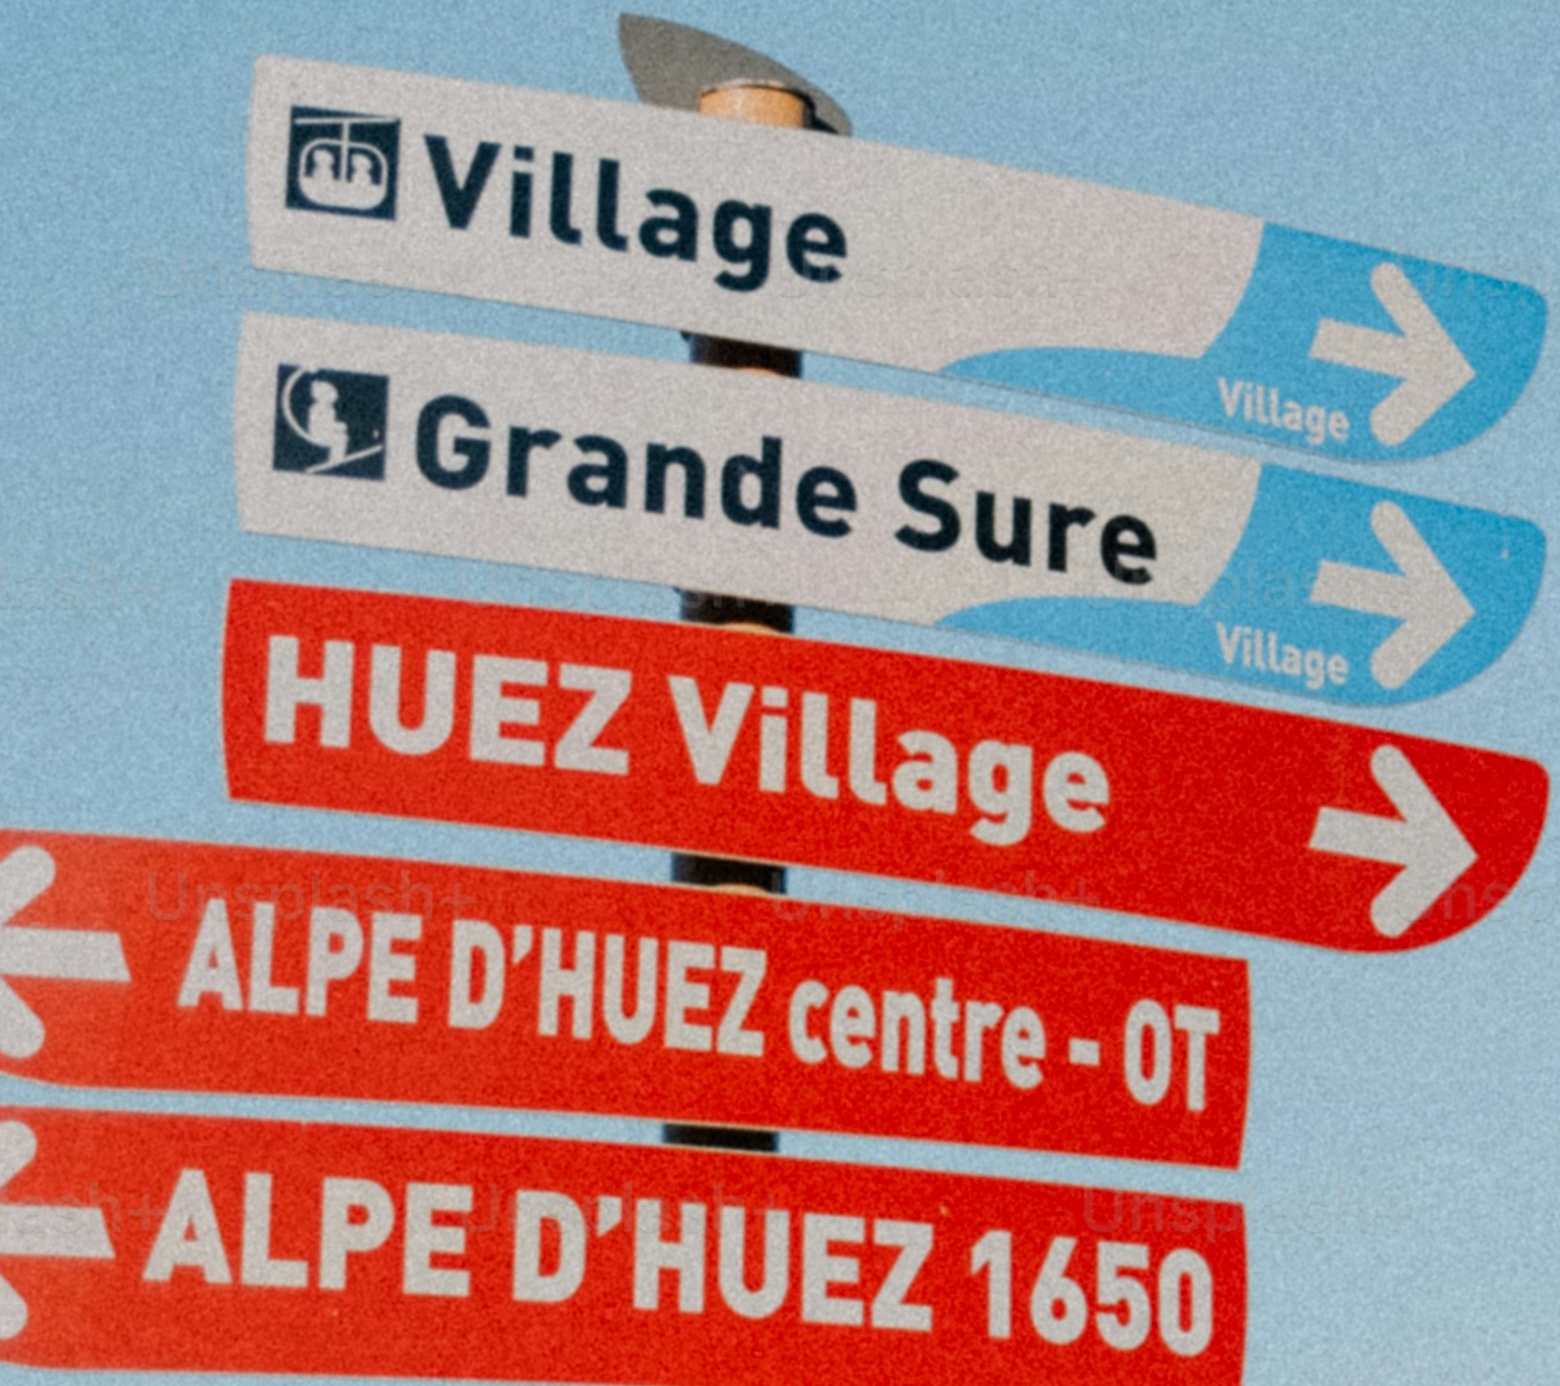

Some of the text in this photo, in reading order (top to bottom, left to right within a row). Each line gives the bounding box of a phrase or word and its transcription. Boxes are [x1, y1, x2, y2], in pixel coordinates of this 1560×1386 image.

[423, 132, 849, 295] Village
[414, 392, 1159, 587] Grande Sure
[1217, 376, 1350, 445] Village
[263, 633, 1110, 847] HUEZ Village
[1216, 621, 1349, 690] Village
[176, 894, 1222, 1112] ALPE D'HUEZ centre - OT
[141, 1166, 474, 1299] ALPE
[511, 1188, 934, 1333] D'HUEZ
[969, 1229, 1215, 1357] 1650
